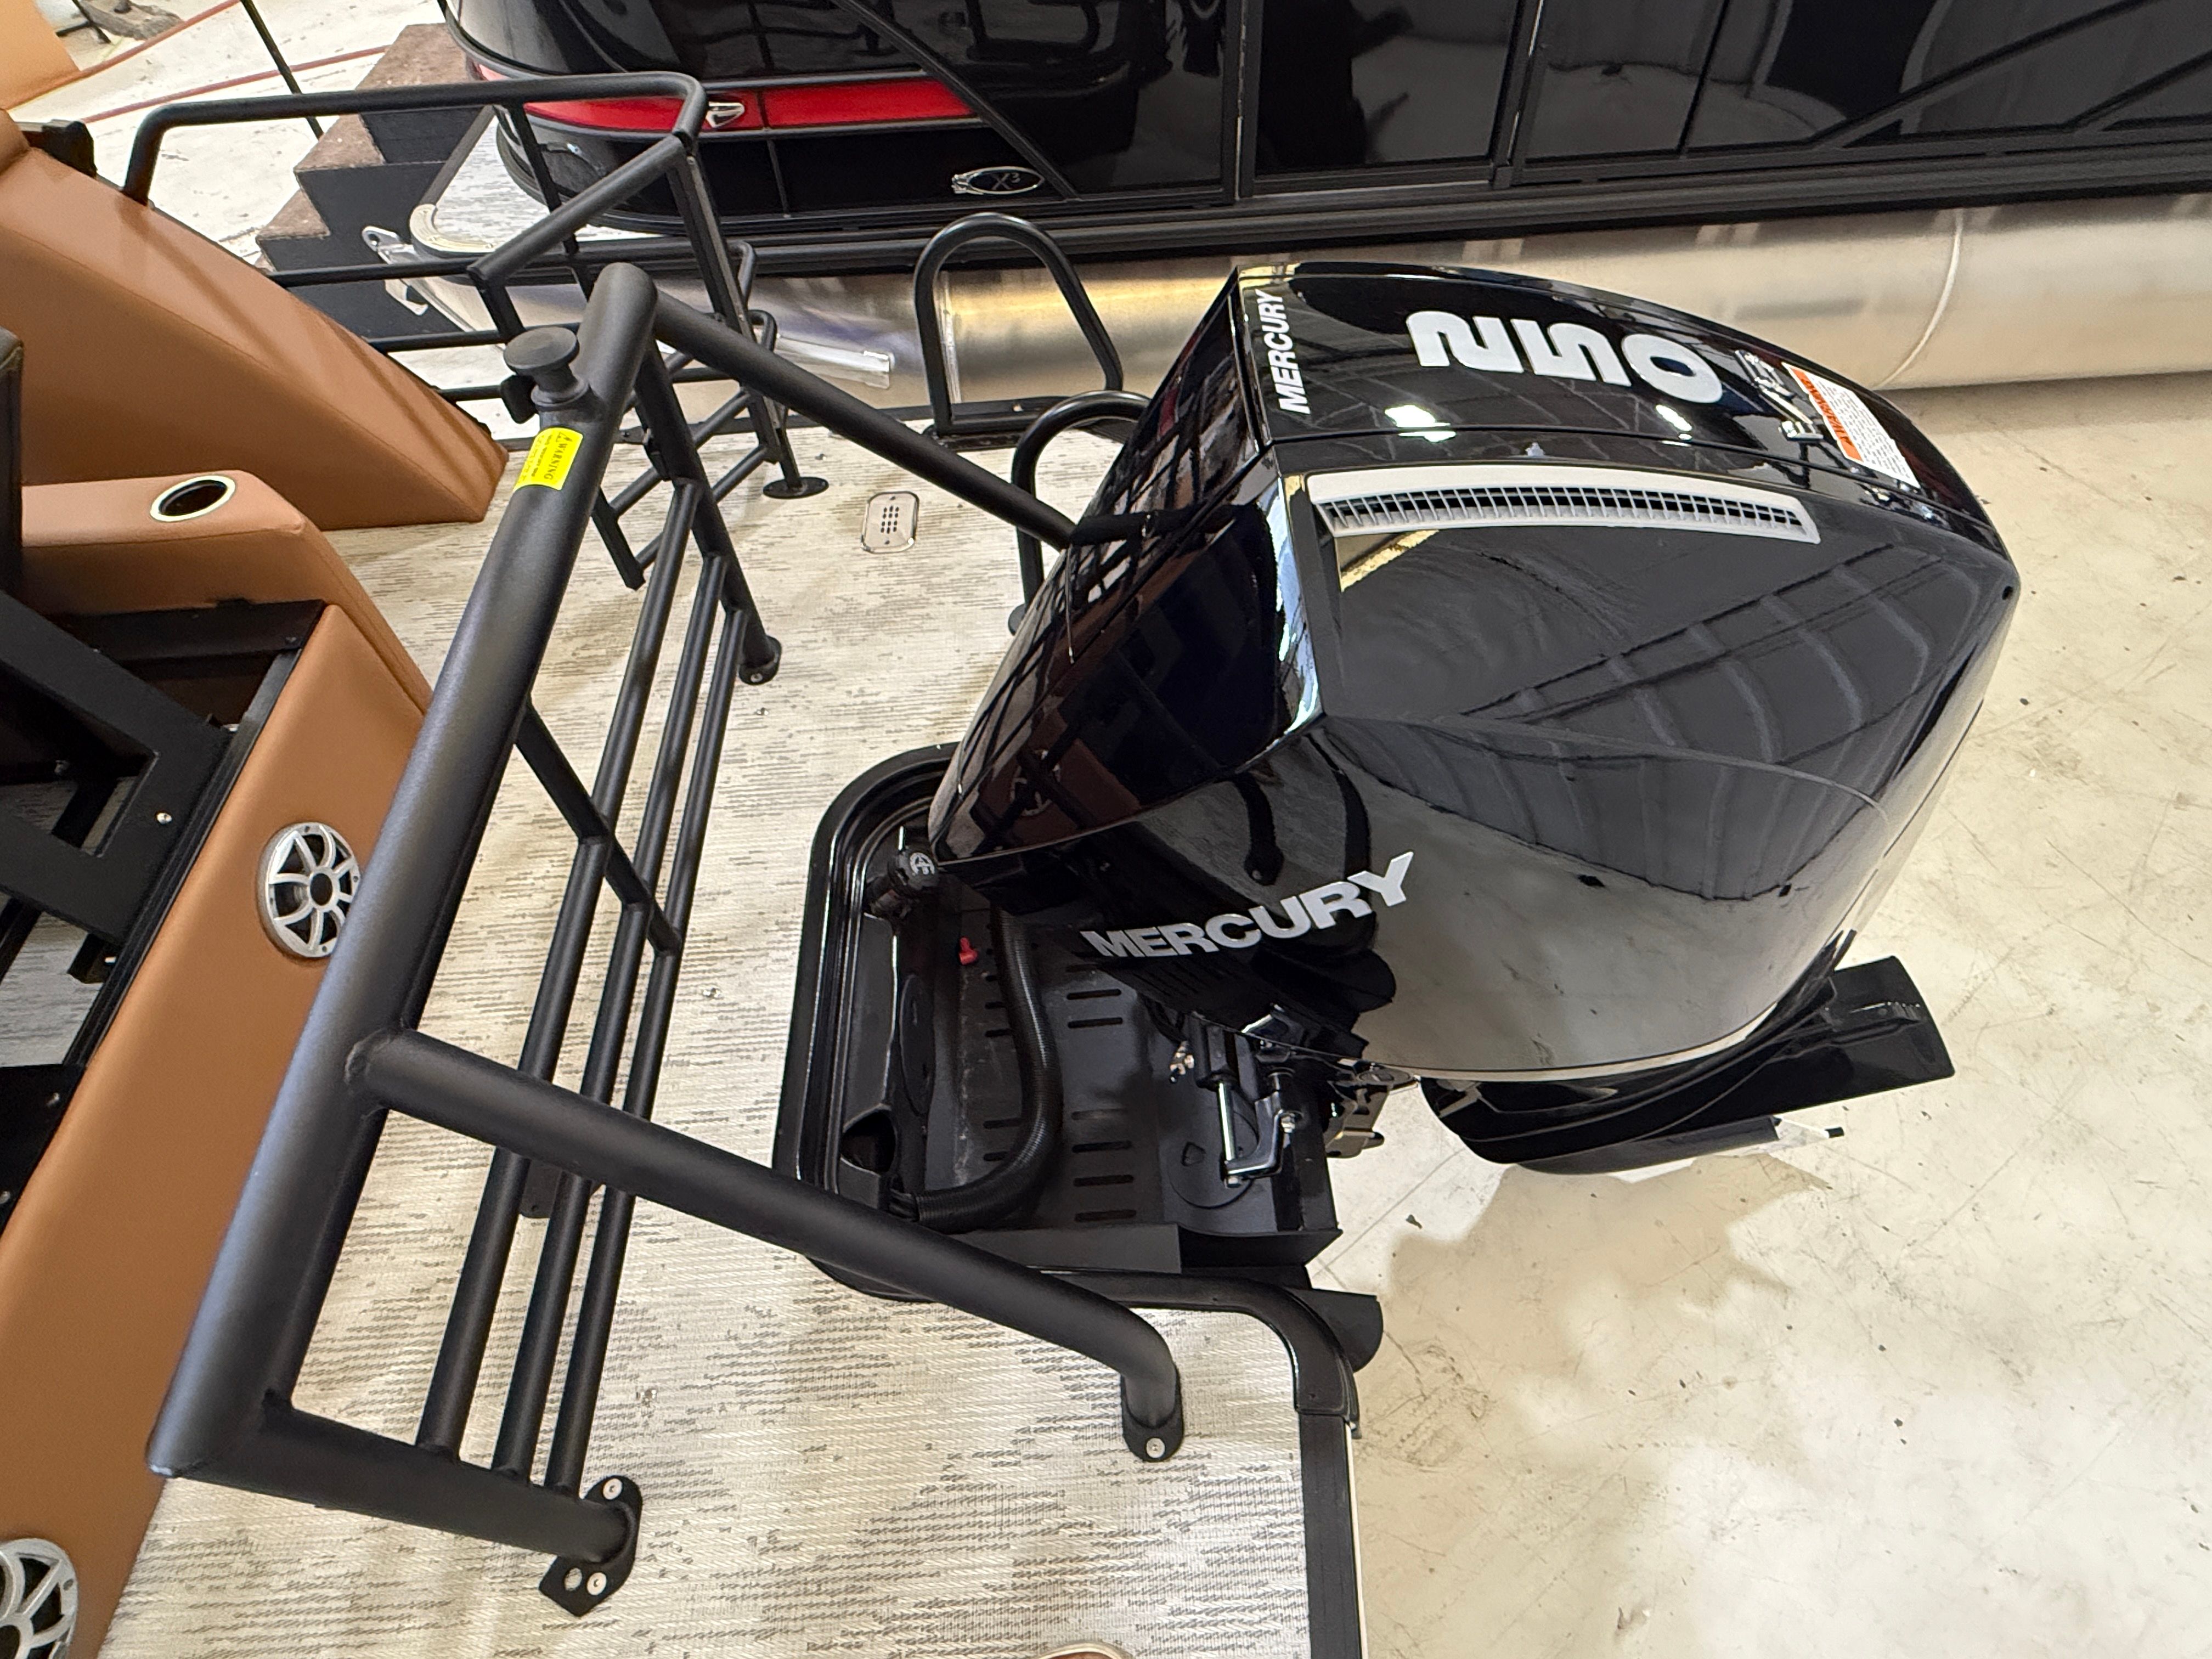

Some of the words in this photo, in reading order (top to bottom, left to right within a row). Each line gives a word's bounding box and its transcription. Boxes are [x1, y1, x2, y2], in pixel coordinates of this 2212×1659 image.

[1254, 290, 1311, 414] MERCURY
[1405, 310, 1724, 405] 250
[543, 443, 568, 480] WARNING
[1080, 851, 1414, 958] MERCURY
